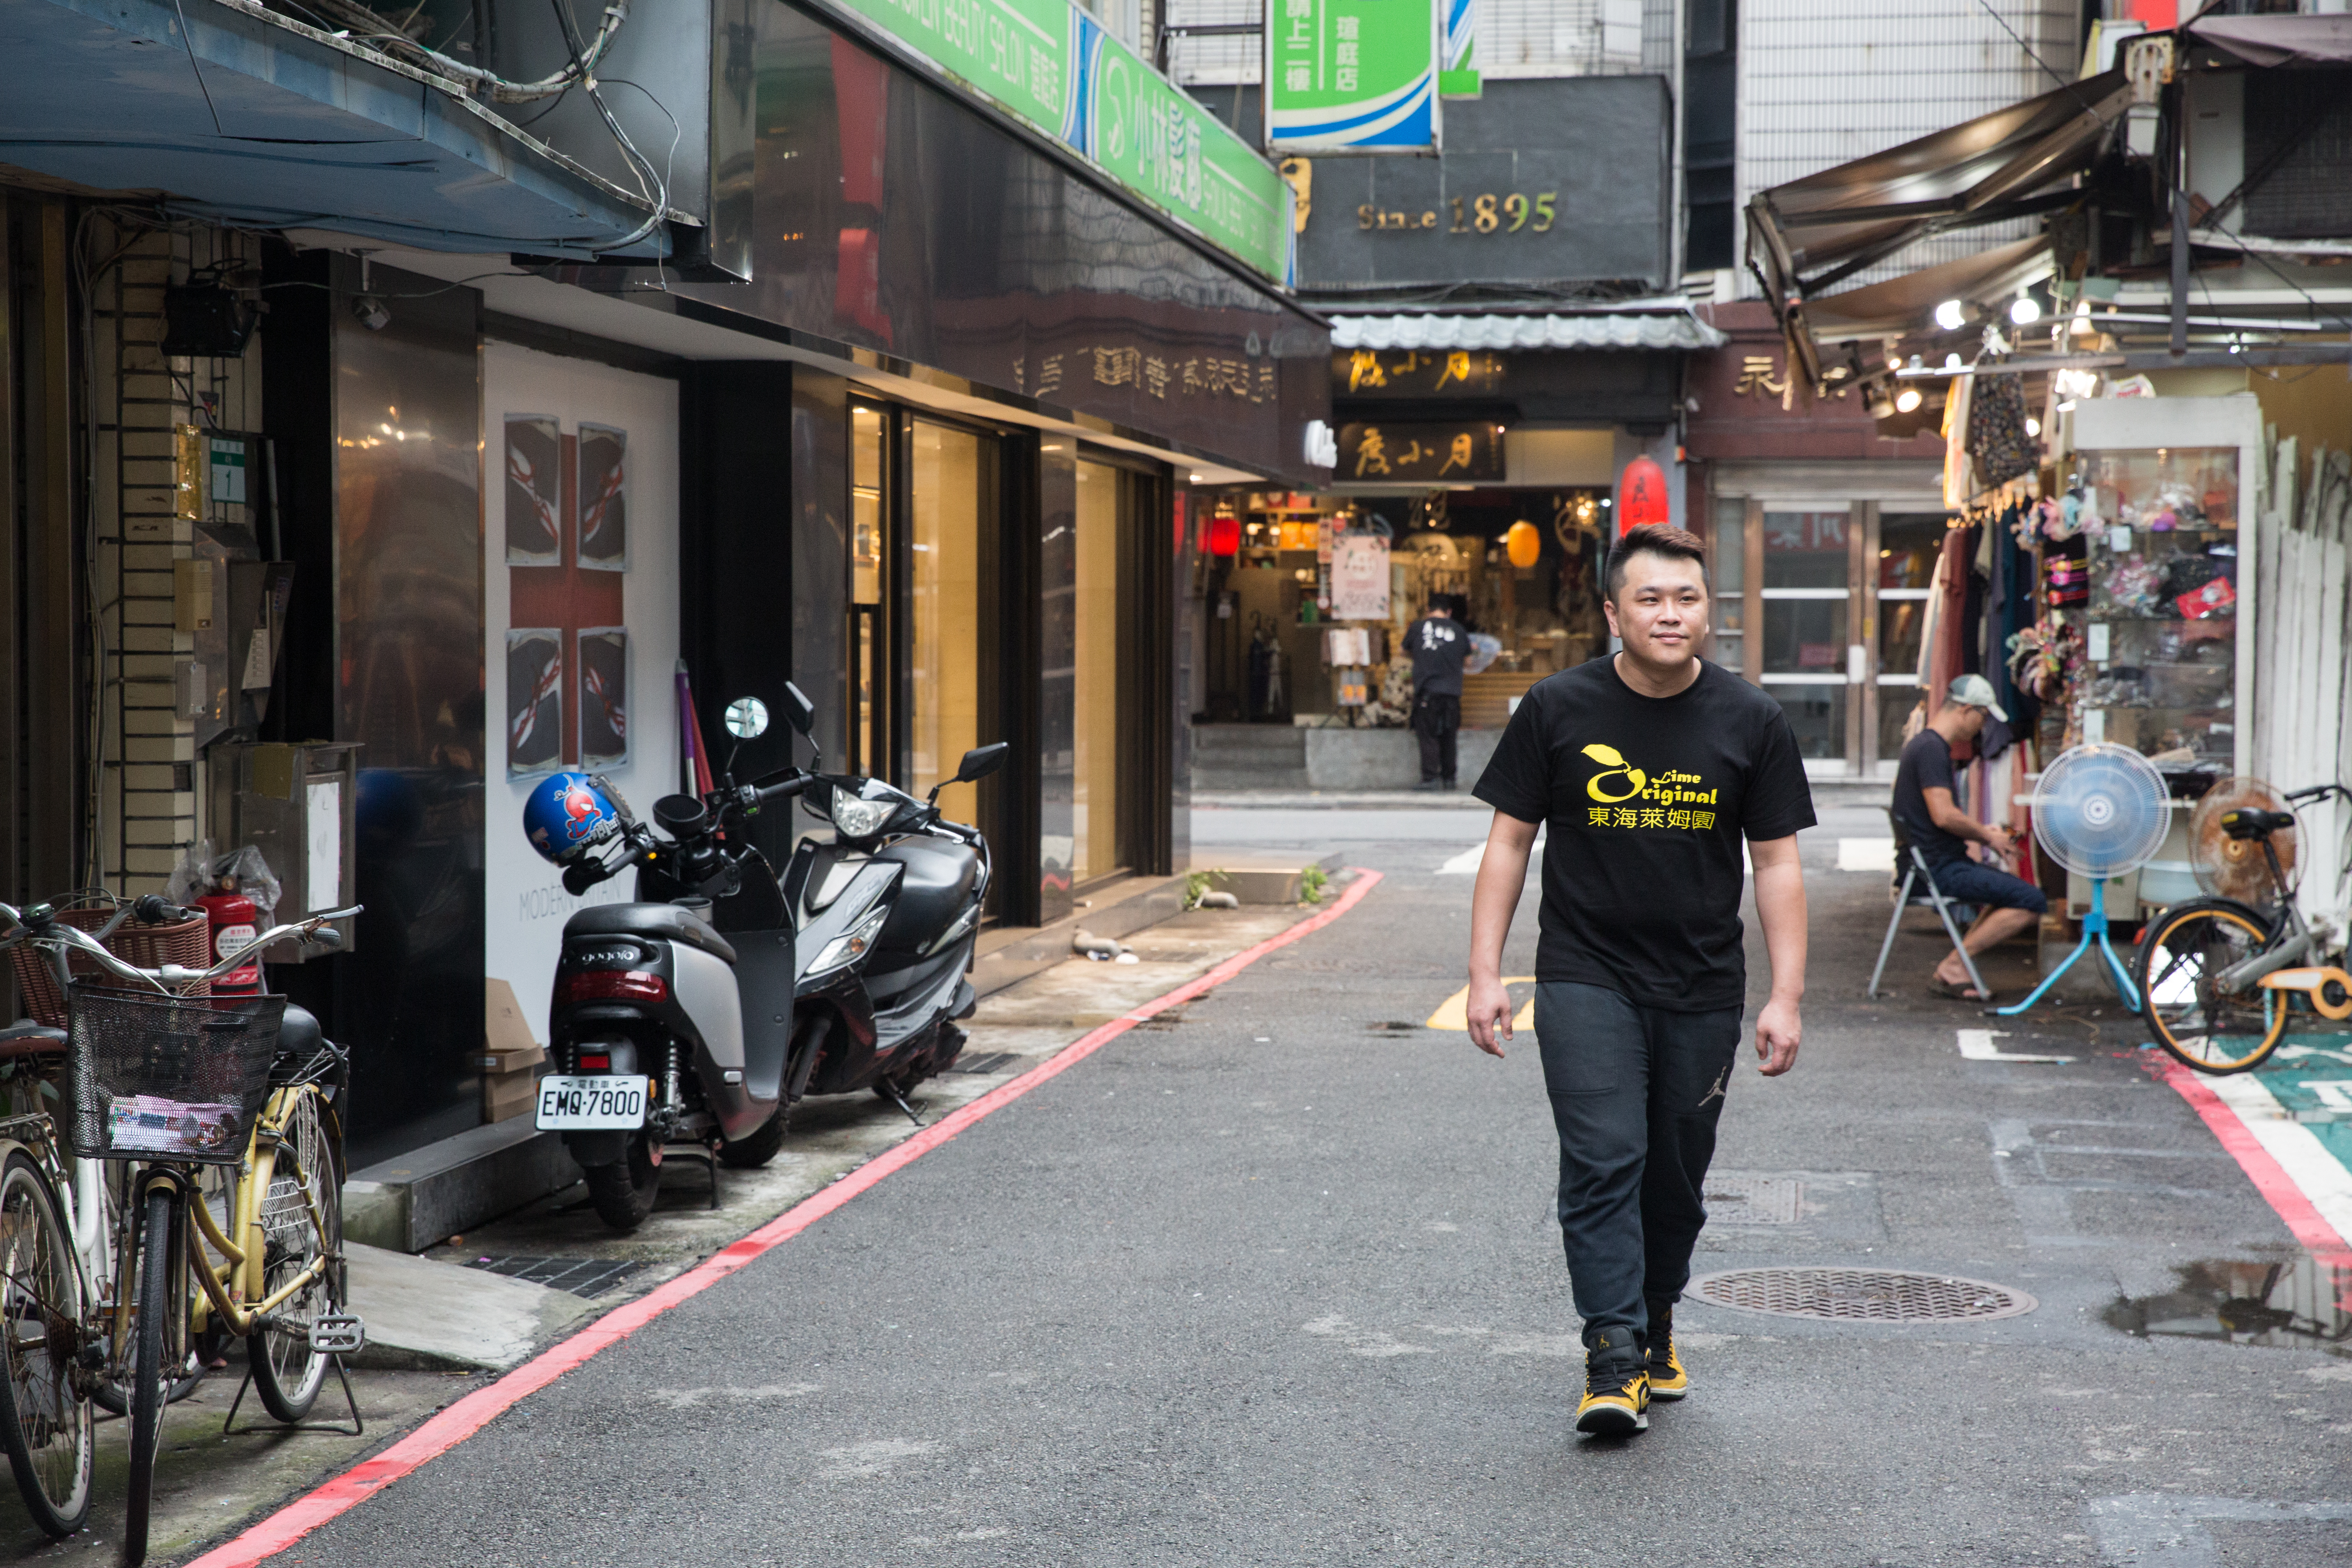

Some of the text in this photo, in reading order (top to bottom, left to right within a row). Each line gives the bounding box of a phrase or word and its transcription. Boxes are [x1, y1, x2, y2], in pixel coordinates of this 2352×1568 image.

[1358, 191, 1558, 233] Since 1895
[1651, 770, 1701, 784] Lime
[1588, 806, 1715, 829] 東海萊姆園
[578, 1080, 609, 1089] 電動車
